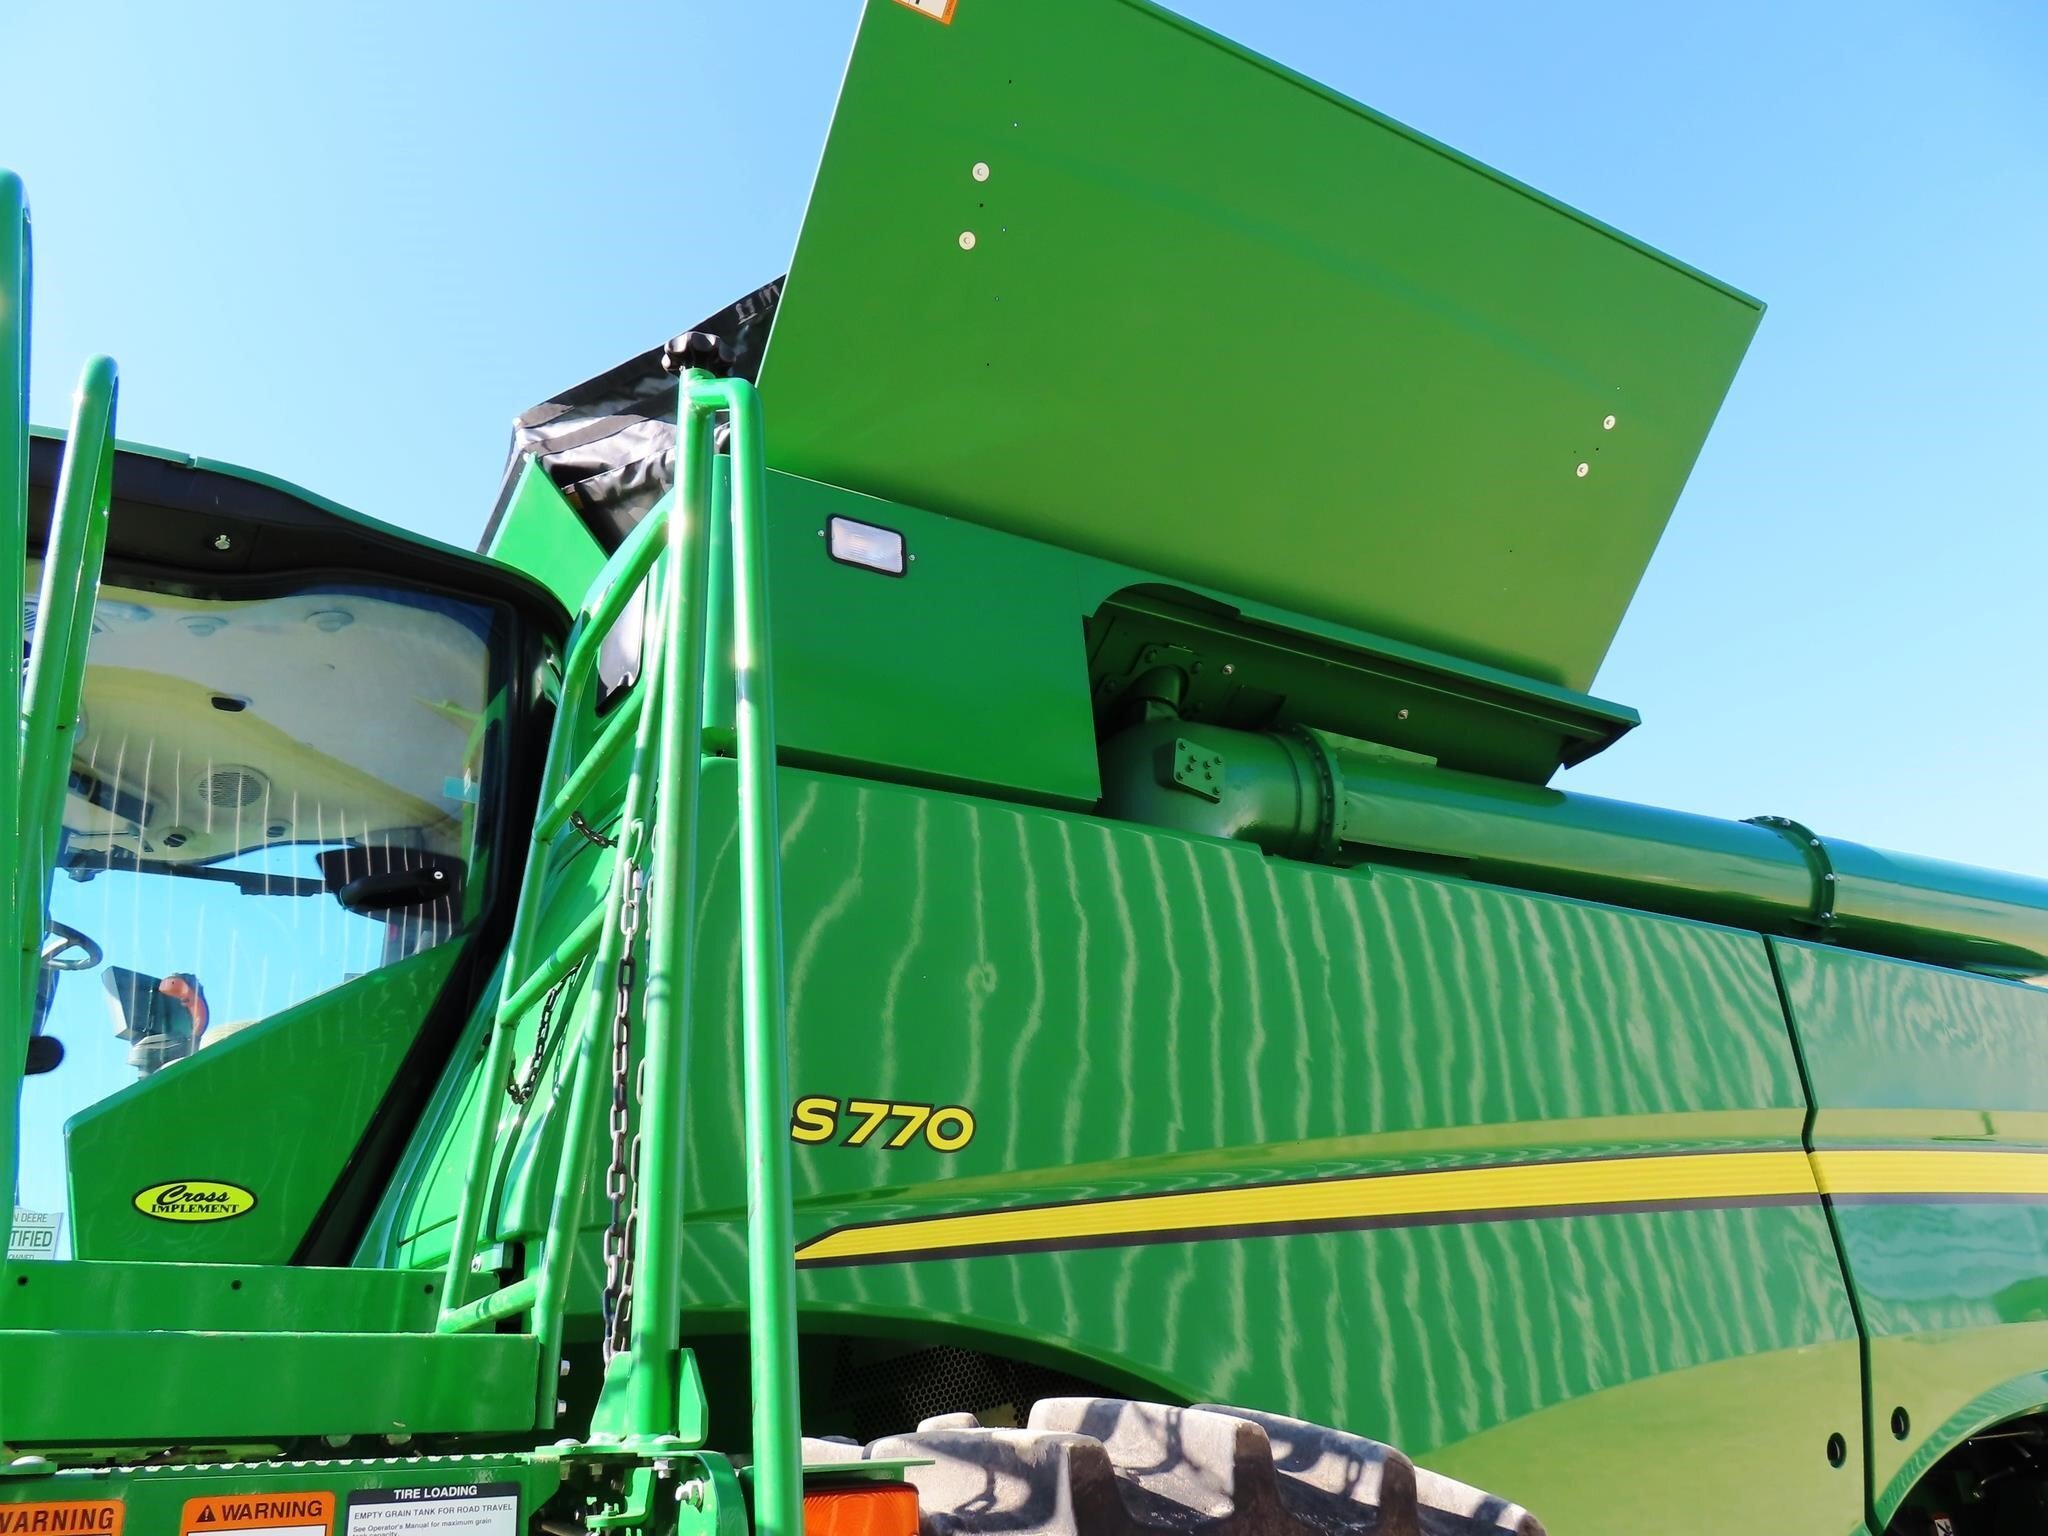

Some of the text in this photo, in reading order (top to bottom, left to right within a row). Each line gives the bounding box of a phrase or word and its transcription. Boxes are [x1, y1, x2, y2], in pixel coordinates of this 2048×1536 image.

[157, 1185, 230, 1205] Cross
[151, 1204, 239, 1213] IMPLEMENT
[21, 1213, 48, 1223] DEERE
[394, 1485, 477, 1499] TIRE LOADING
[222, 1500, 322, 1521] WARNING
[354, 1503, 512, 1520] EMPTY GRAIN TANK FOR ROAD TRAVEL
[368, 1523, 403, 1532] Operator's
[405, 1521, 429, 1529] Manual
[441, 1519, 474, 1527] maximum
[475, 1518, 491, 1527] grain
